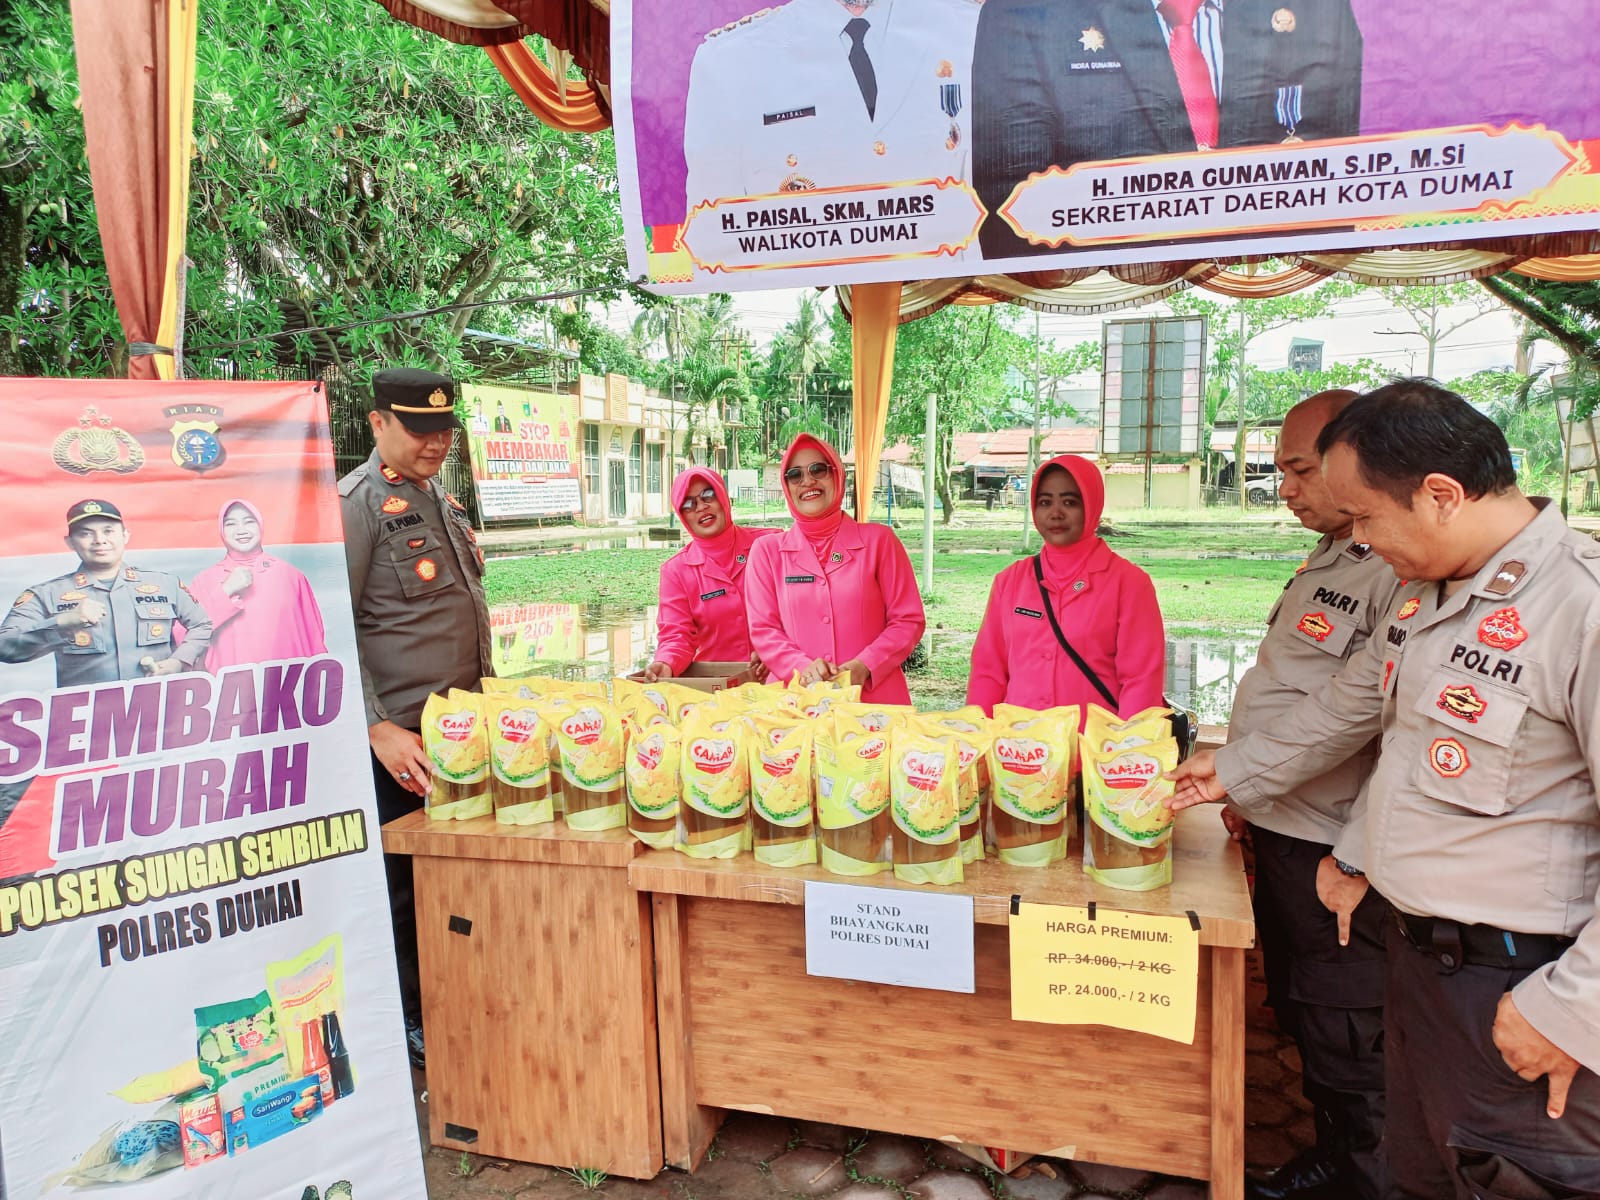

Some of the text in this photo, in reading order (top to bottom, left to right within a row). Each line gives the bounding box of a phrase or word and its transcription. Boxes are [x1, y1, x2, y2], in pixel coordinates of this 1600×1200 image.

[776, 110, 804, 121] PAISAL
[1092, 144, 1466, 198] H. INDRA GUNAWAN, S.IP, M.Si
[1051, 169, 1514, 228] SEKRETARIAT DAERAH KOTA DUMAI
[721, 195, 935, 231] H. PAISAL, SKM, MARS
[739, 222, 919, 254] WALIKOTA DUMAI
[169, 405, 217, 416] RIAU
[520, 422, 550, 441] STOP
[485, 440, 569, 460] MEMBAKAR
[135, 595, 168, 604] POLRI
[1313, 586, 1359, 615] POLRI
[1450, 643, 1523, 685] POLRI
[0, 659, 344, 777] SEMBAKO
[693, 744, 733, 763] CAMAR
[997, 744, 1046, 763] CAMAR
[58, 742, 310, 853] MURAH
[0, 811, 367, 934] POLSEK SUNGAI SEMBILAN
[856, 902, 901, 918] STAND
[97, 879, 304, 968] POLRES DUMAI
[829, 915, 930, 936] BHAYANGKARI
[1046, 920, 1173, 944] HARGA PREMIUM:
[830, 929, 930, 950] POLRES DUMAI
[1048, 953, 1072, 965] RP.
[1075, 953, 1127, 969] 34.000,-
[1138, 960, 1146, 972] 2
[1150, 961, 1173, 975] KG
[1048, 984, 1072, 997] RP.
[1075, 984, 1128, 1000] 24.000,-
[1138, 992, 1146, 1004] 2
[1150, 994, 1171, 1008] KG
[256, 1094, 293, 1115] SariWangi
